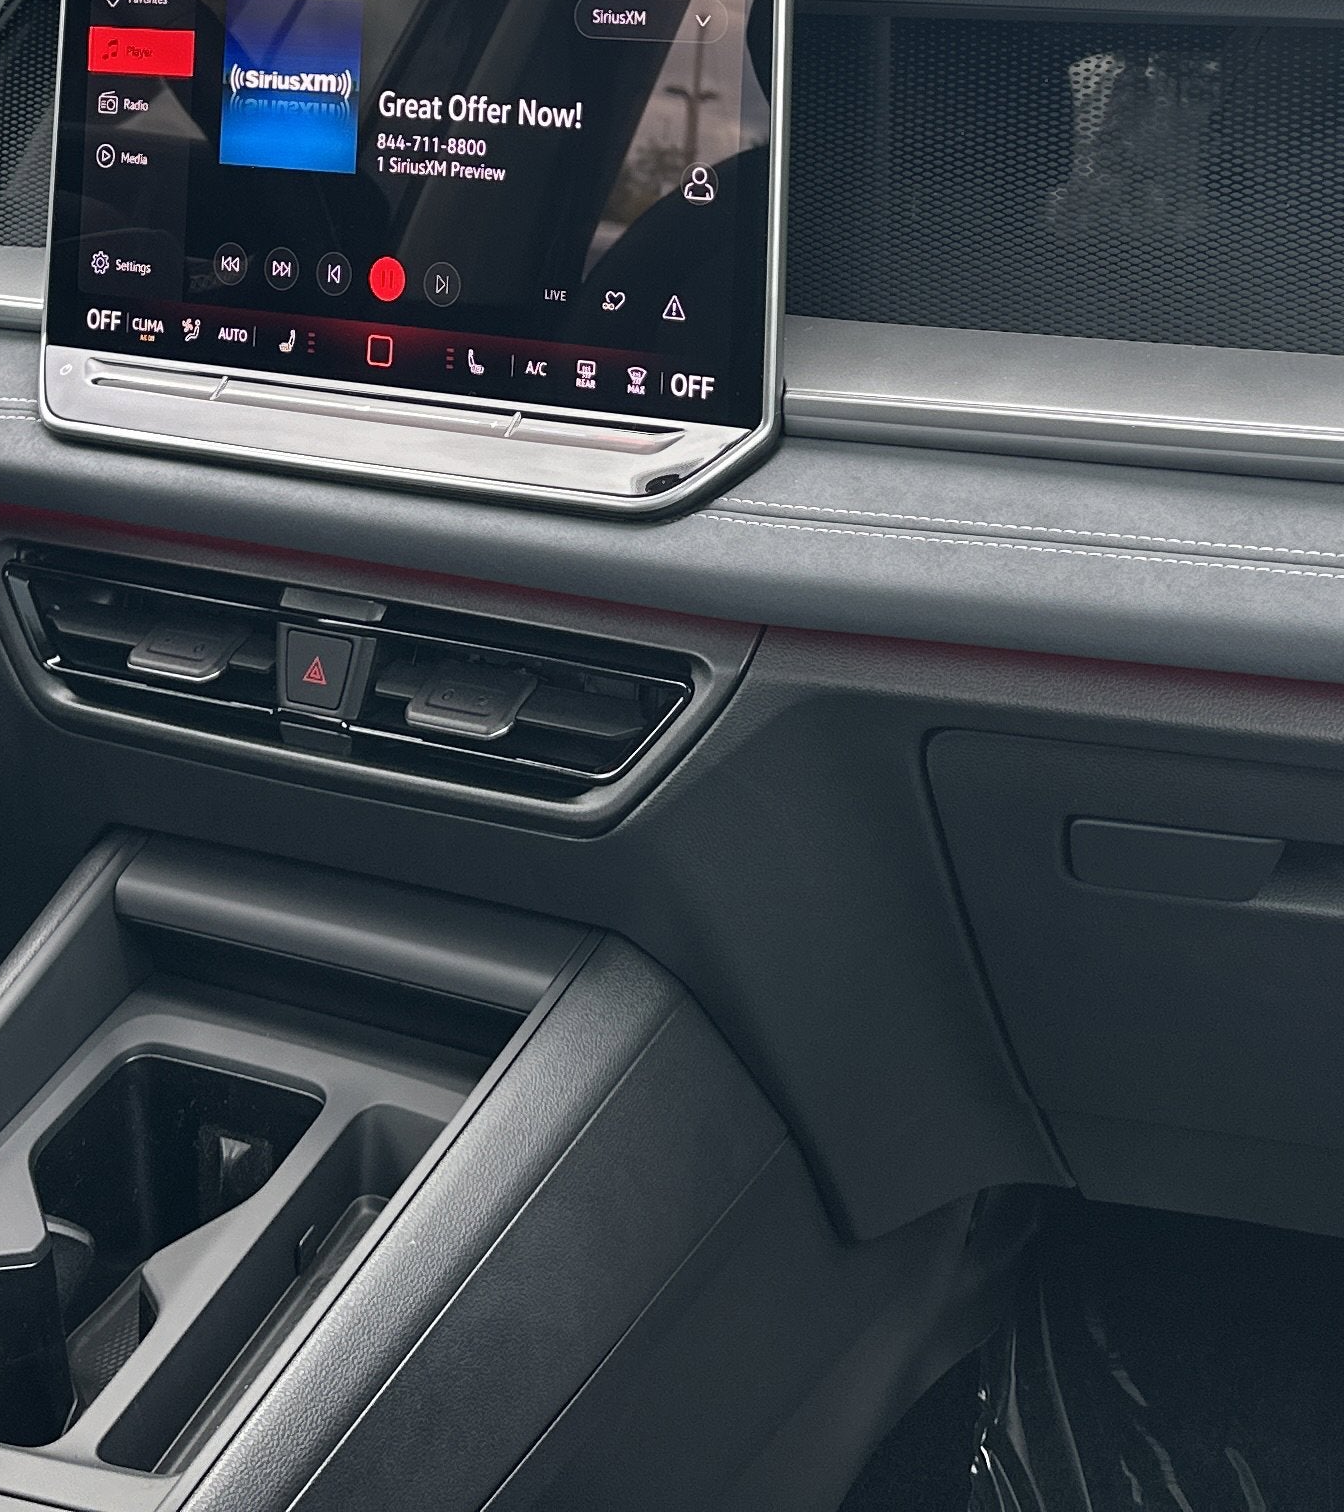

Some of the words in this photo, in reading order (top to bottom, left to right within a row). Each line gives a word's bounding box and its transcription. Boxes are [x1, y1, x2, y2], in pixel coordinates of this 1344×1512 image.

[592, 8, 647, 26] SiriusXM
[126, 45, 154, 59] Player
[123, 98, 149, 112] Radio
[378, 90, 443, 120] Great
[448, 94, 512, 124] Offer
[518, 98, 583, 130] Now!
[377, 133, 487, 156] 844-711-8800
[120, 151, 148, 165] Media
[377, 156, 384, 172] 1
[389, 156, 447, 177] SiriusXM
[451, 161, 506, 181] Preview
[115, 258, 151, 276] Settings
[544, 289, 567, 302] LIVE
[86, 307, 122, 332] OFF
[132, 317, 164, 334] CLIMA
[217, 327, 248, 343] AUTO
[525, 360, 548, 377] A/C
[575, 378, 596, 389] REAR
[627, 383, 646, 395] MAX
[670, 372, 716, 400] OFF
